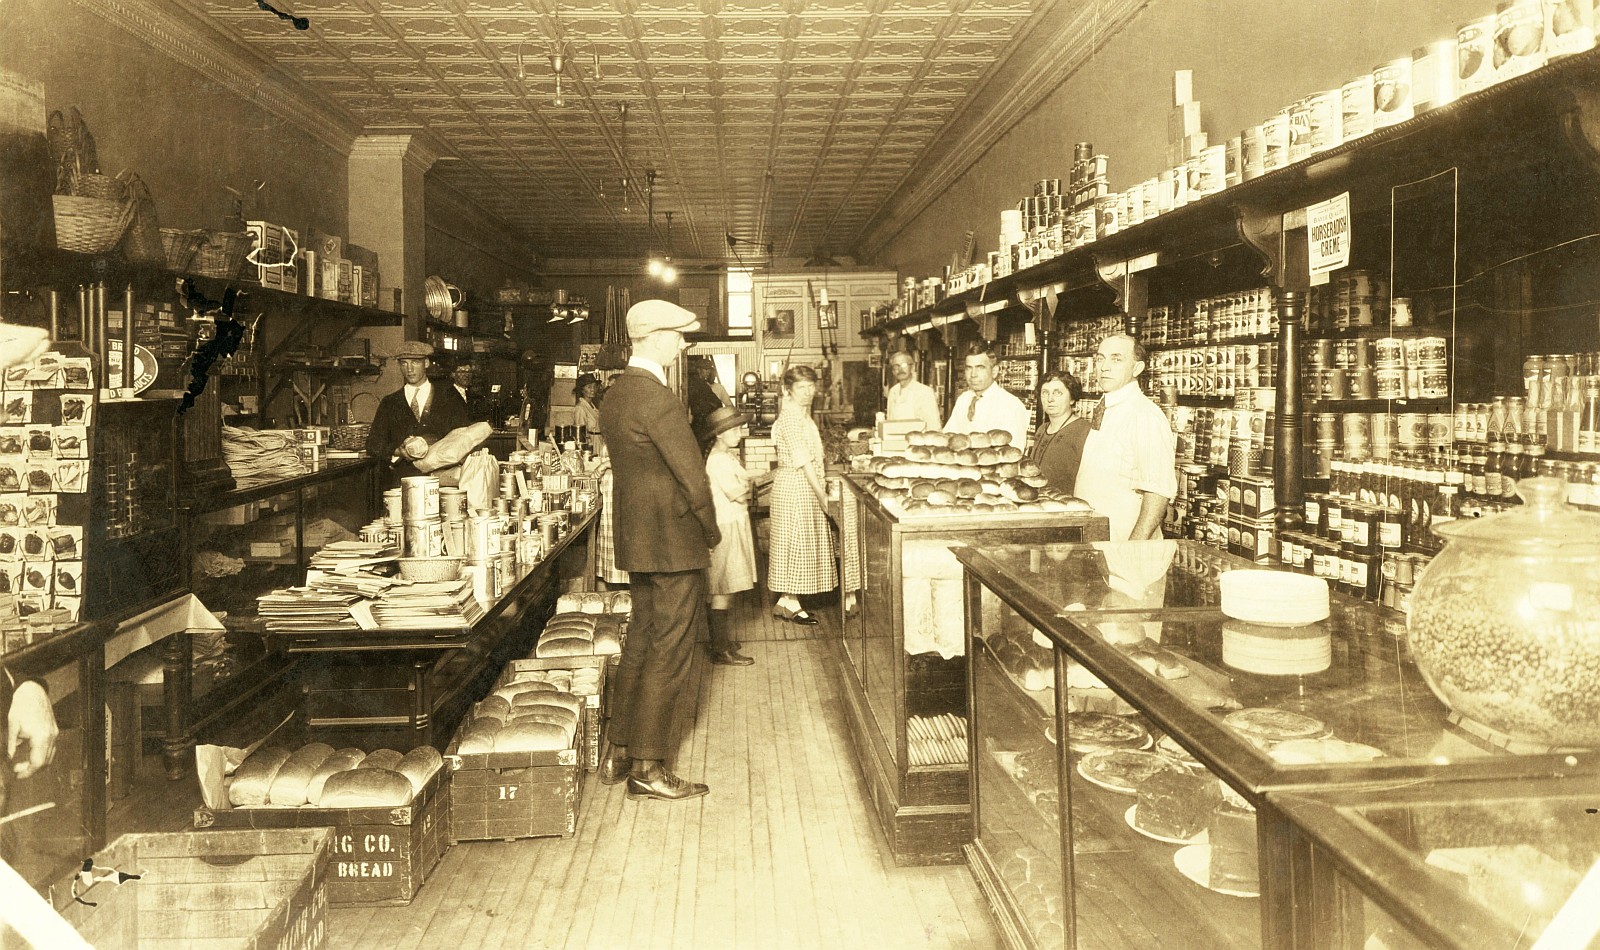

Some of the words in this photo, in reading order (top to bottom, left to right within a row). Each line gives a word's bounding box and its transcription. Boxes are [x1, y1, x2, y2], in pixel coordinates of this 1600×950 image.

[1311, 216, 1347, 243] HORSERADISH
[1320, 236, 1341, 257] CREME
[112, 342, 140, 355] BRD
[117, 373, 153, 397] PDUCTS
[498, 786, 518, 800] 17
[364, 834, 396, 853] CO.
[337, 862, 394, 878] BREAD
